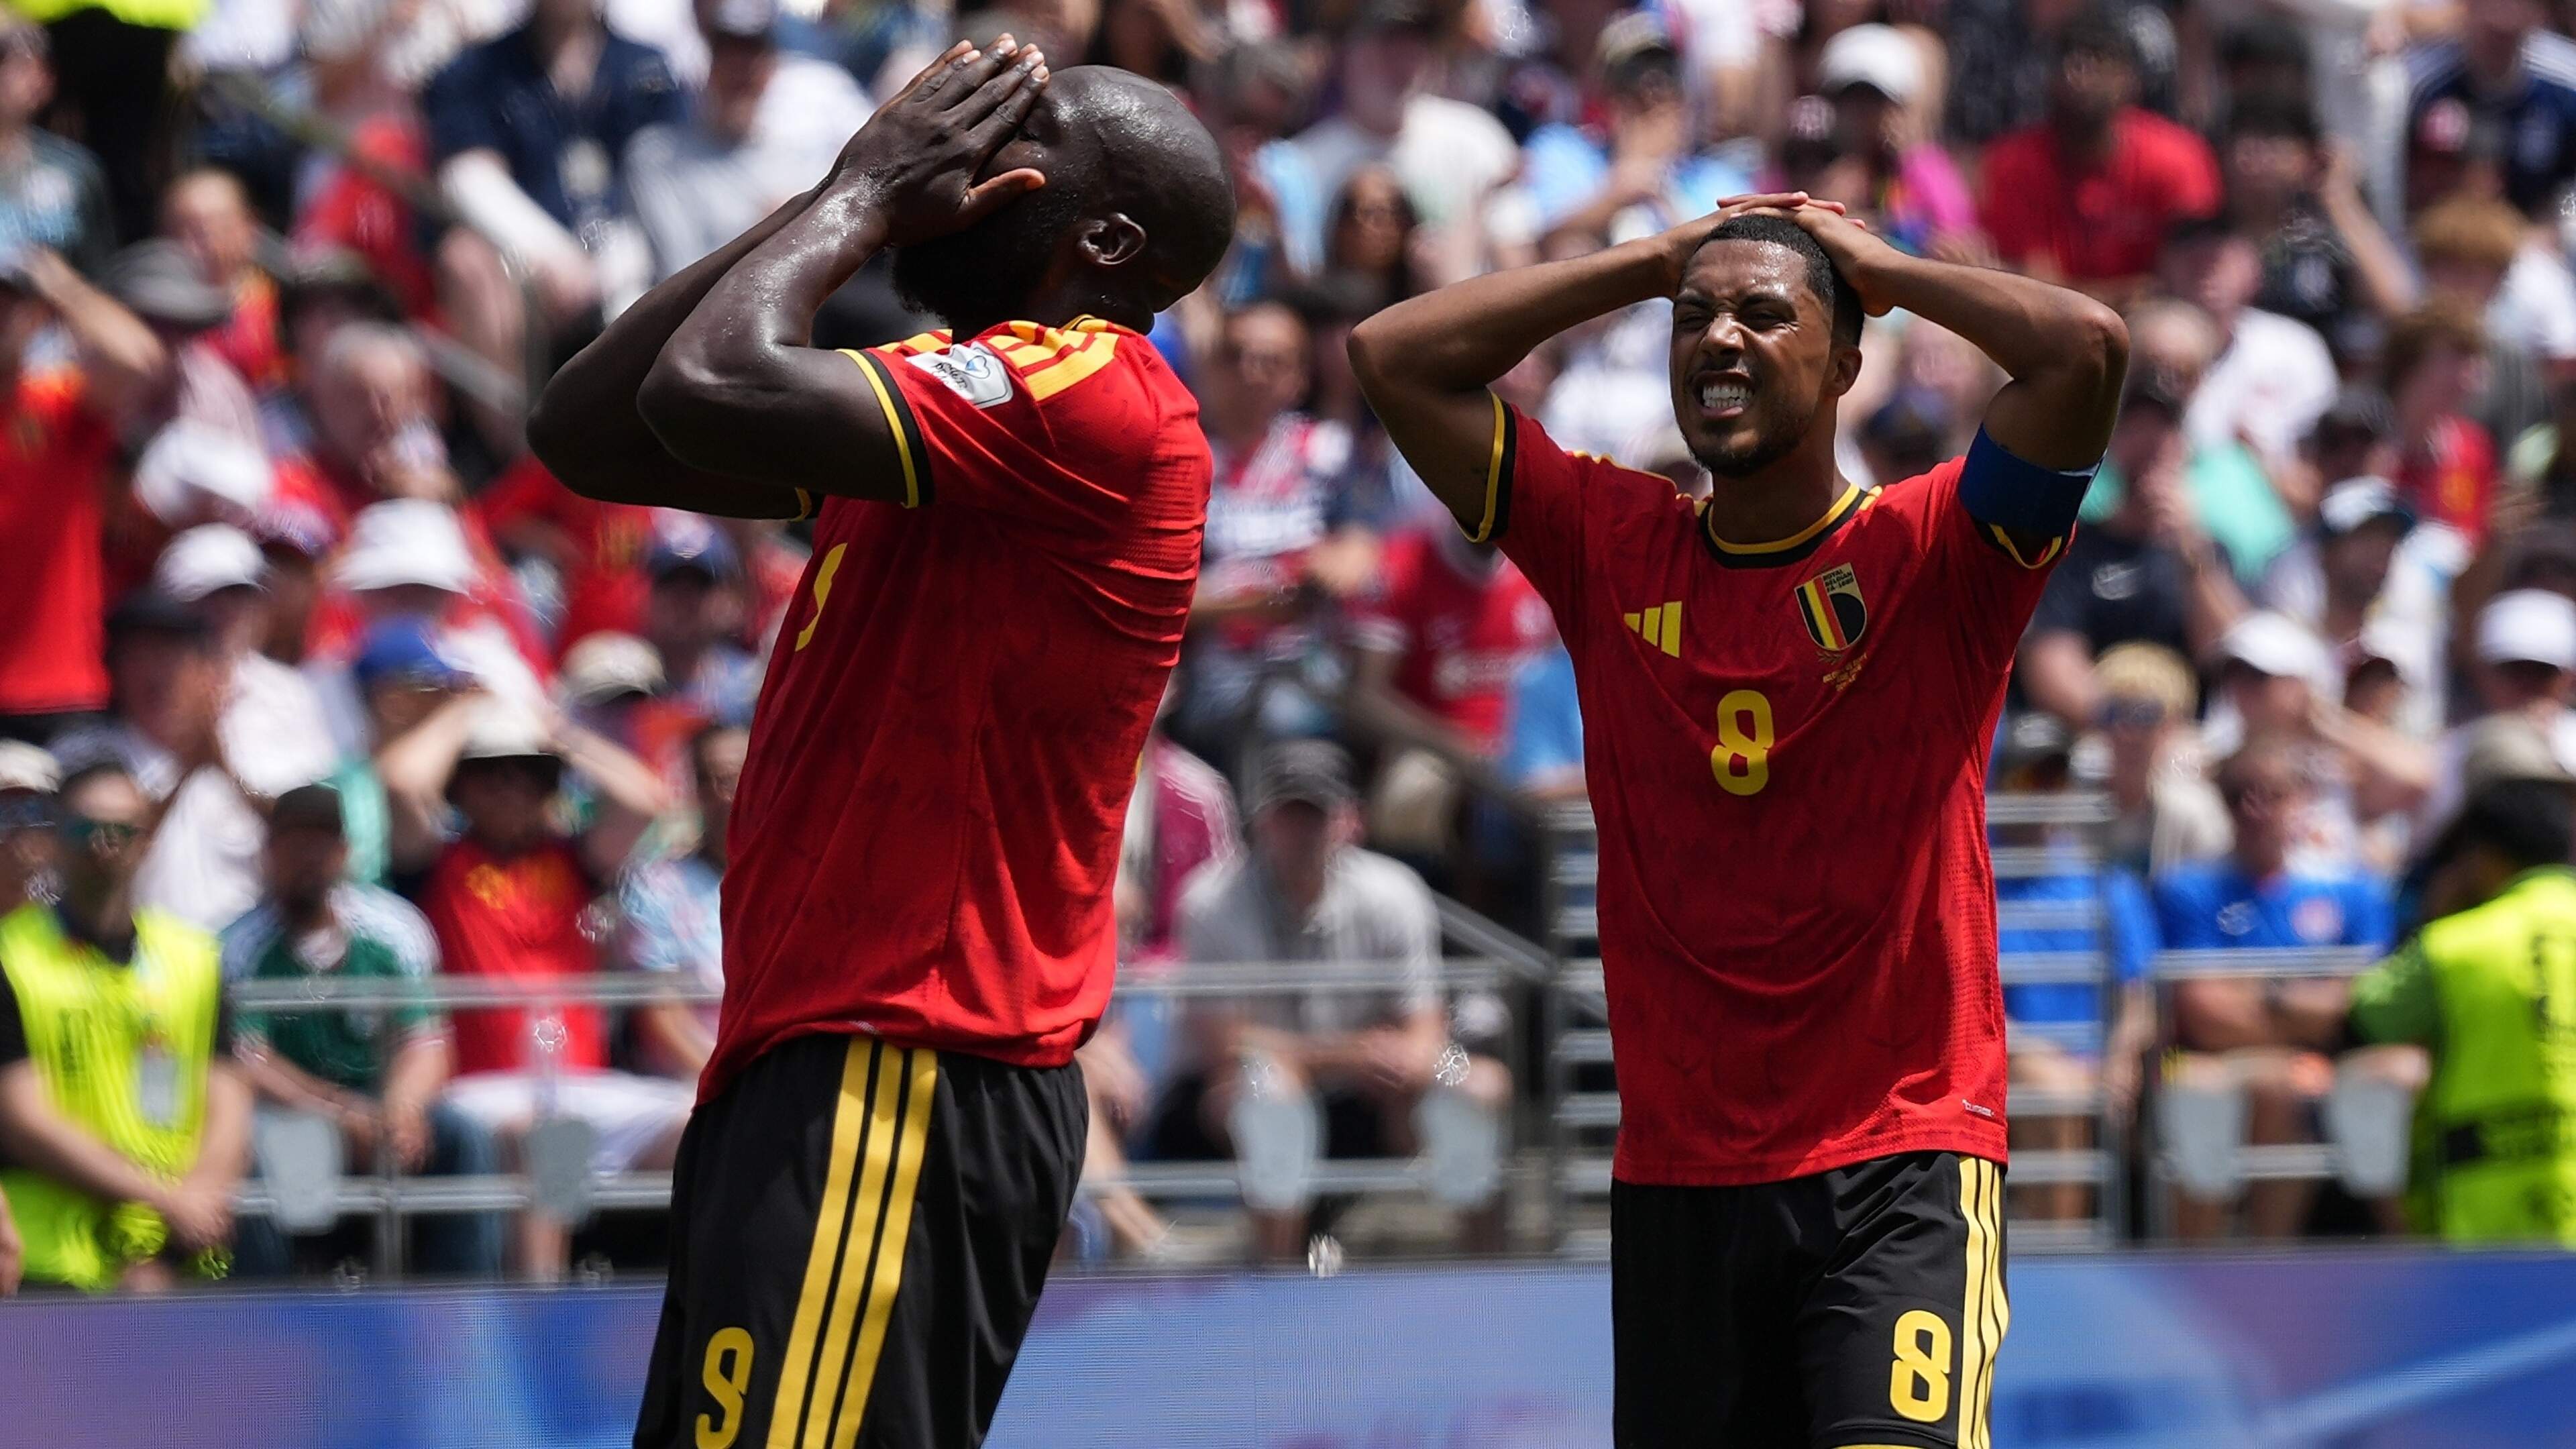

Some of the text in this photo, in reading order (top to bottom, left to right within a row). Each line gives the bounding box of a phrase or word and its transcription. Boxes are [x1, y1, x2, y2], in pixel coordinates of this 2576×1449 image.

[1711, 690, 1774, 796] 8
[695, 1326, 755, 1449] 9
[1890, 1310, 1953, 1423] 8
